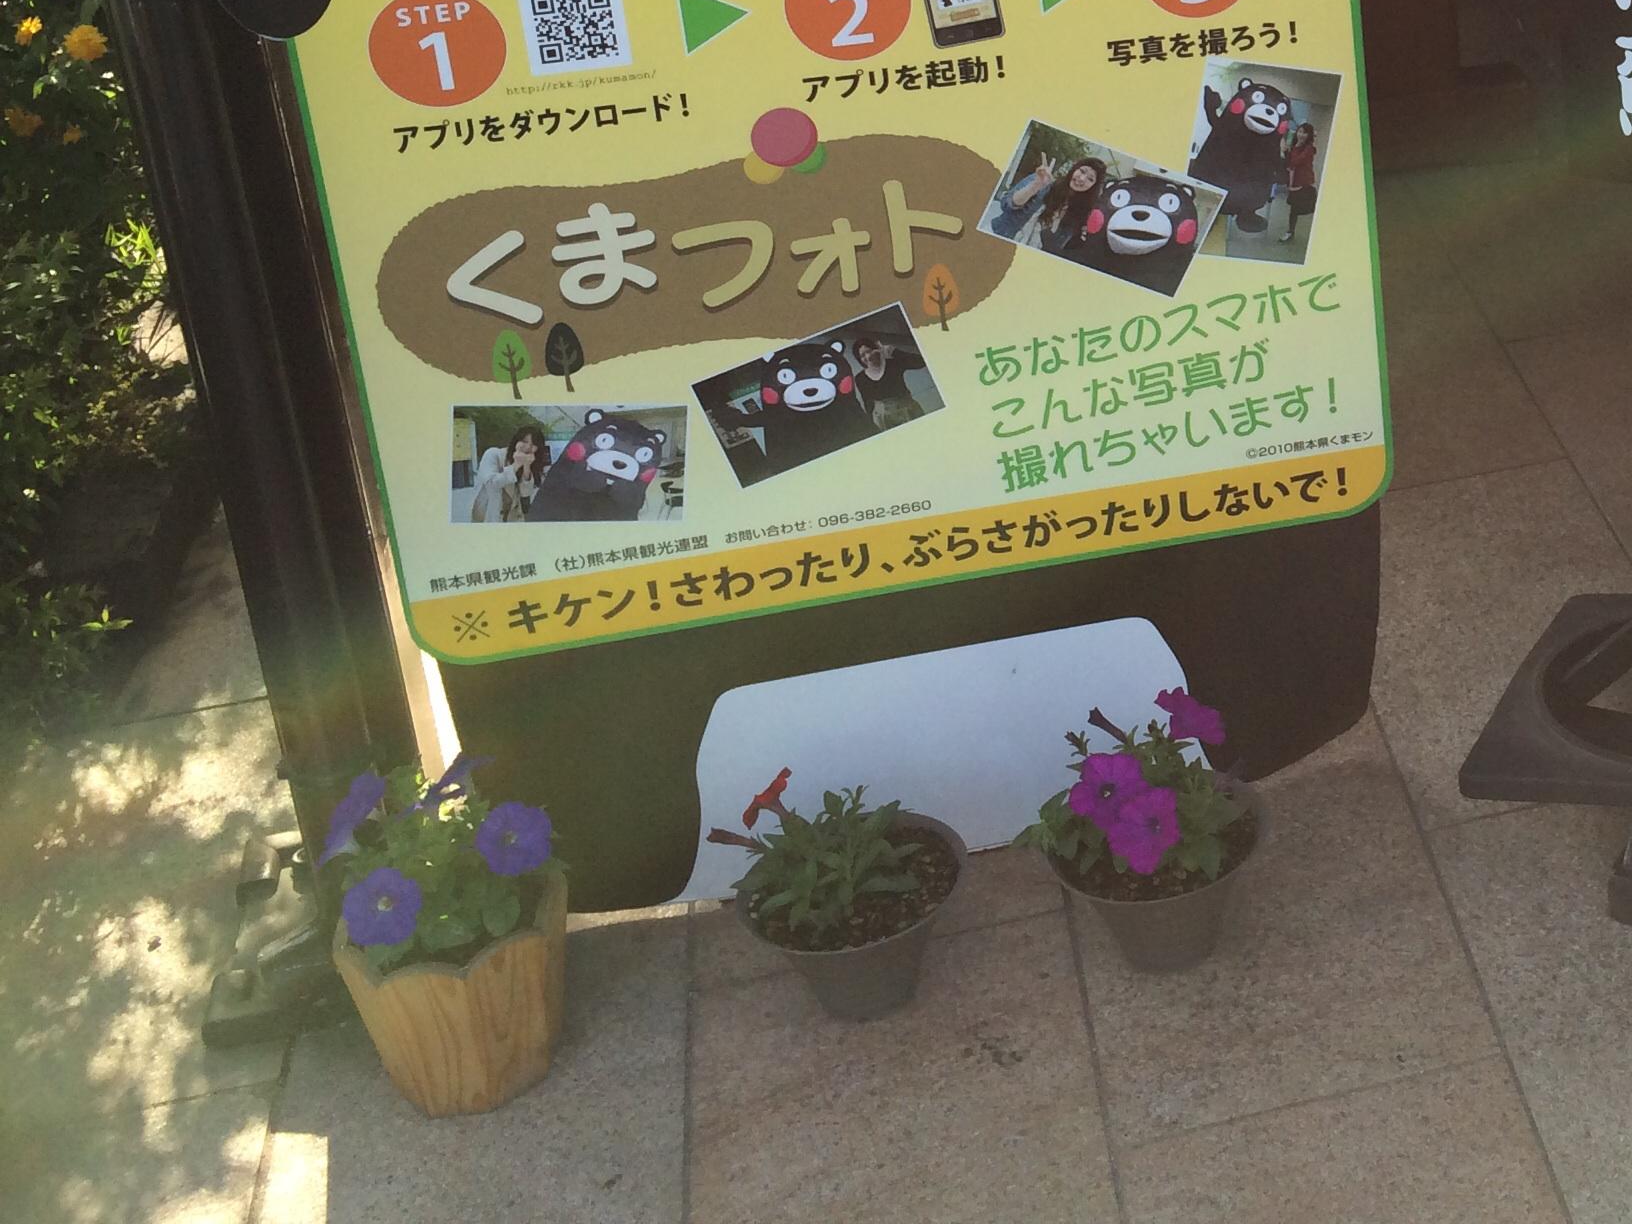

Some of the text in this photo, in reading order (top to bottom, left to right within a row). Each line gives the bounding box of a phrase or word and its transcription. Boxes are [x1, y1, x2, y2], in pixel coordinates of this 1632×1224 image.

[395, 1, 471, 27] STEP
[418, 31, 456, 91] 1
[446, 178, 965, 327] くまフォト
[975, 272, 1342, 387] あなたのスマホで
[991, 337, 1270, 439] こんな写真が
[429, 562, 537, 594] 熊本県観光課
[817, 499, 932, 528] 096-382-2660
